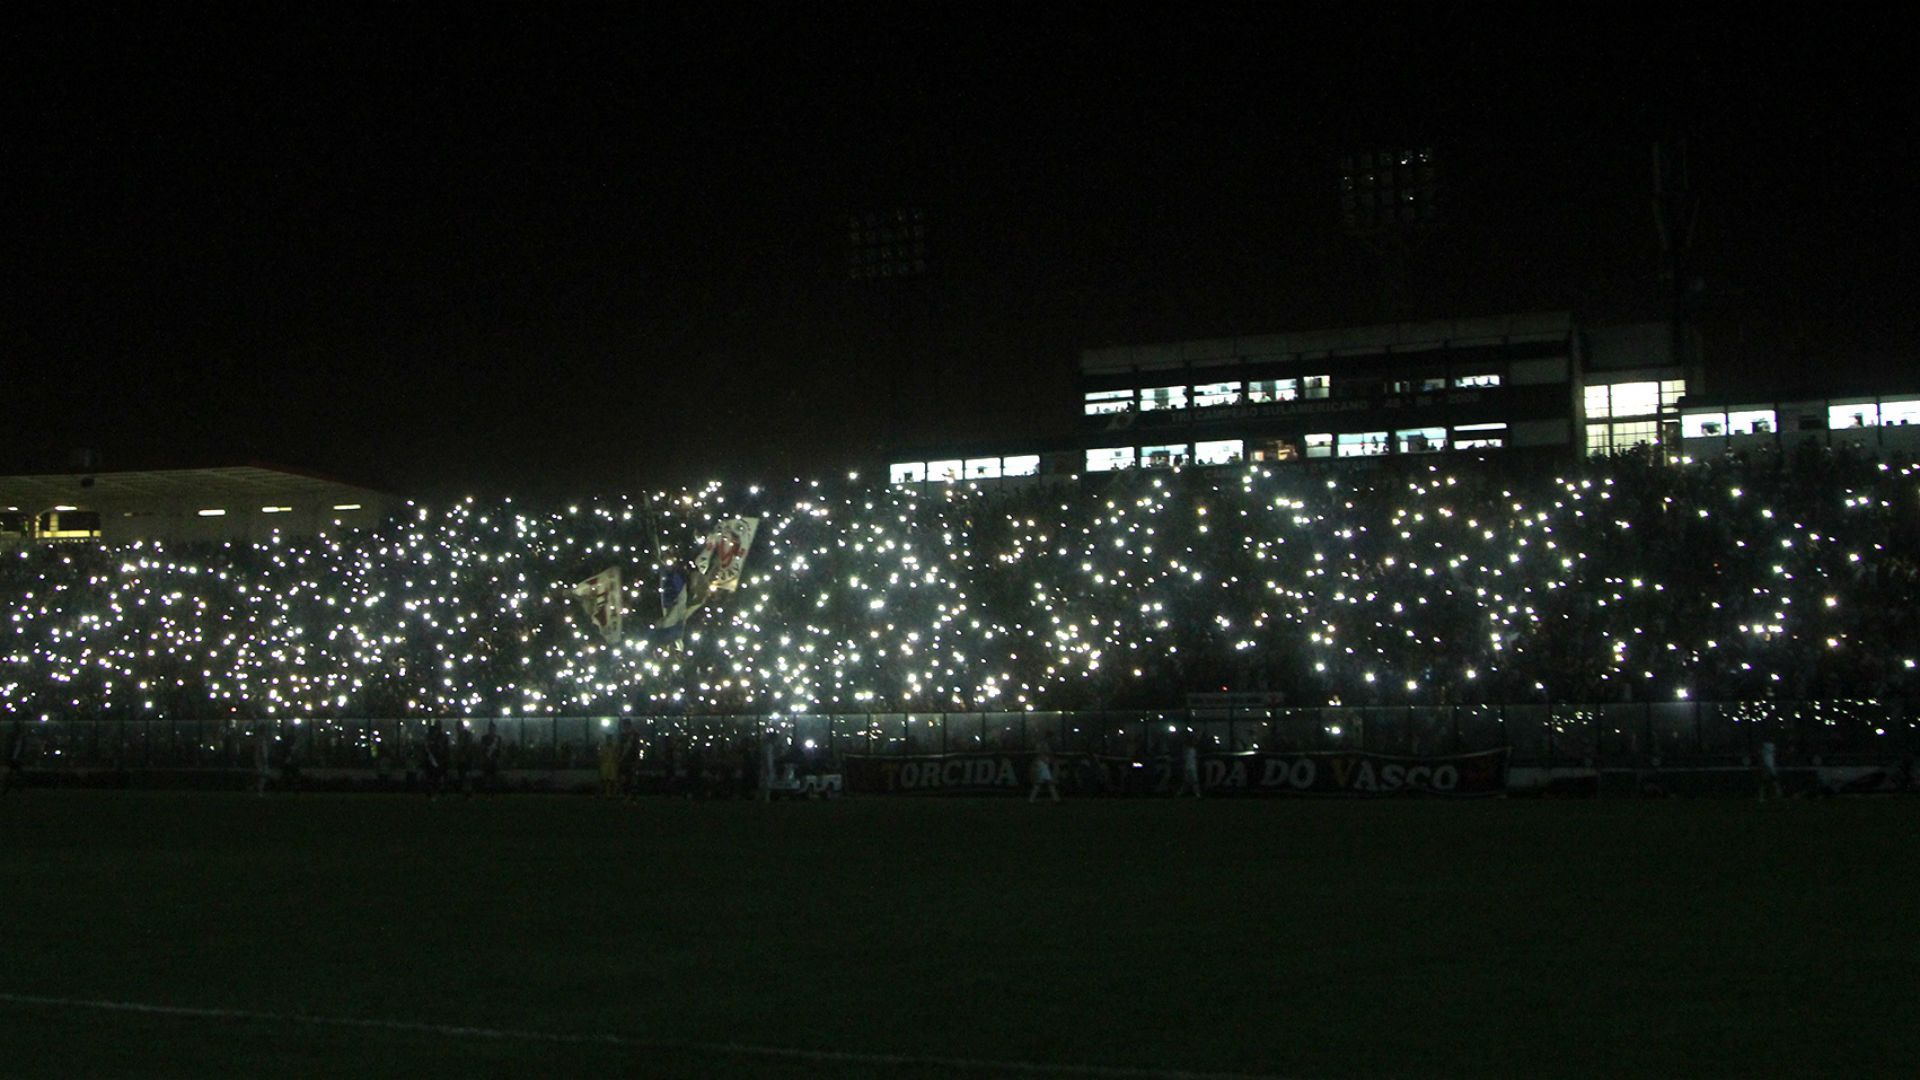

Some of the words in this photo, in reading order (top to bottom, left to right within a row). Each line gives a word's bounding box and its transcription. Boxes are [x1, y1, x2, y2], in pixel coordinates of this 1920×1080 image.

[881, 758, 1018, 790] TORCIDA
[1260, 758, 1316, 788] DO
[1331, 758, 1458, 791] VASCO
